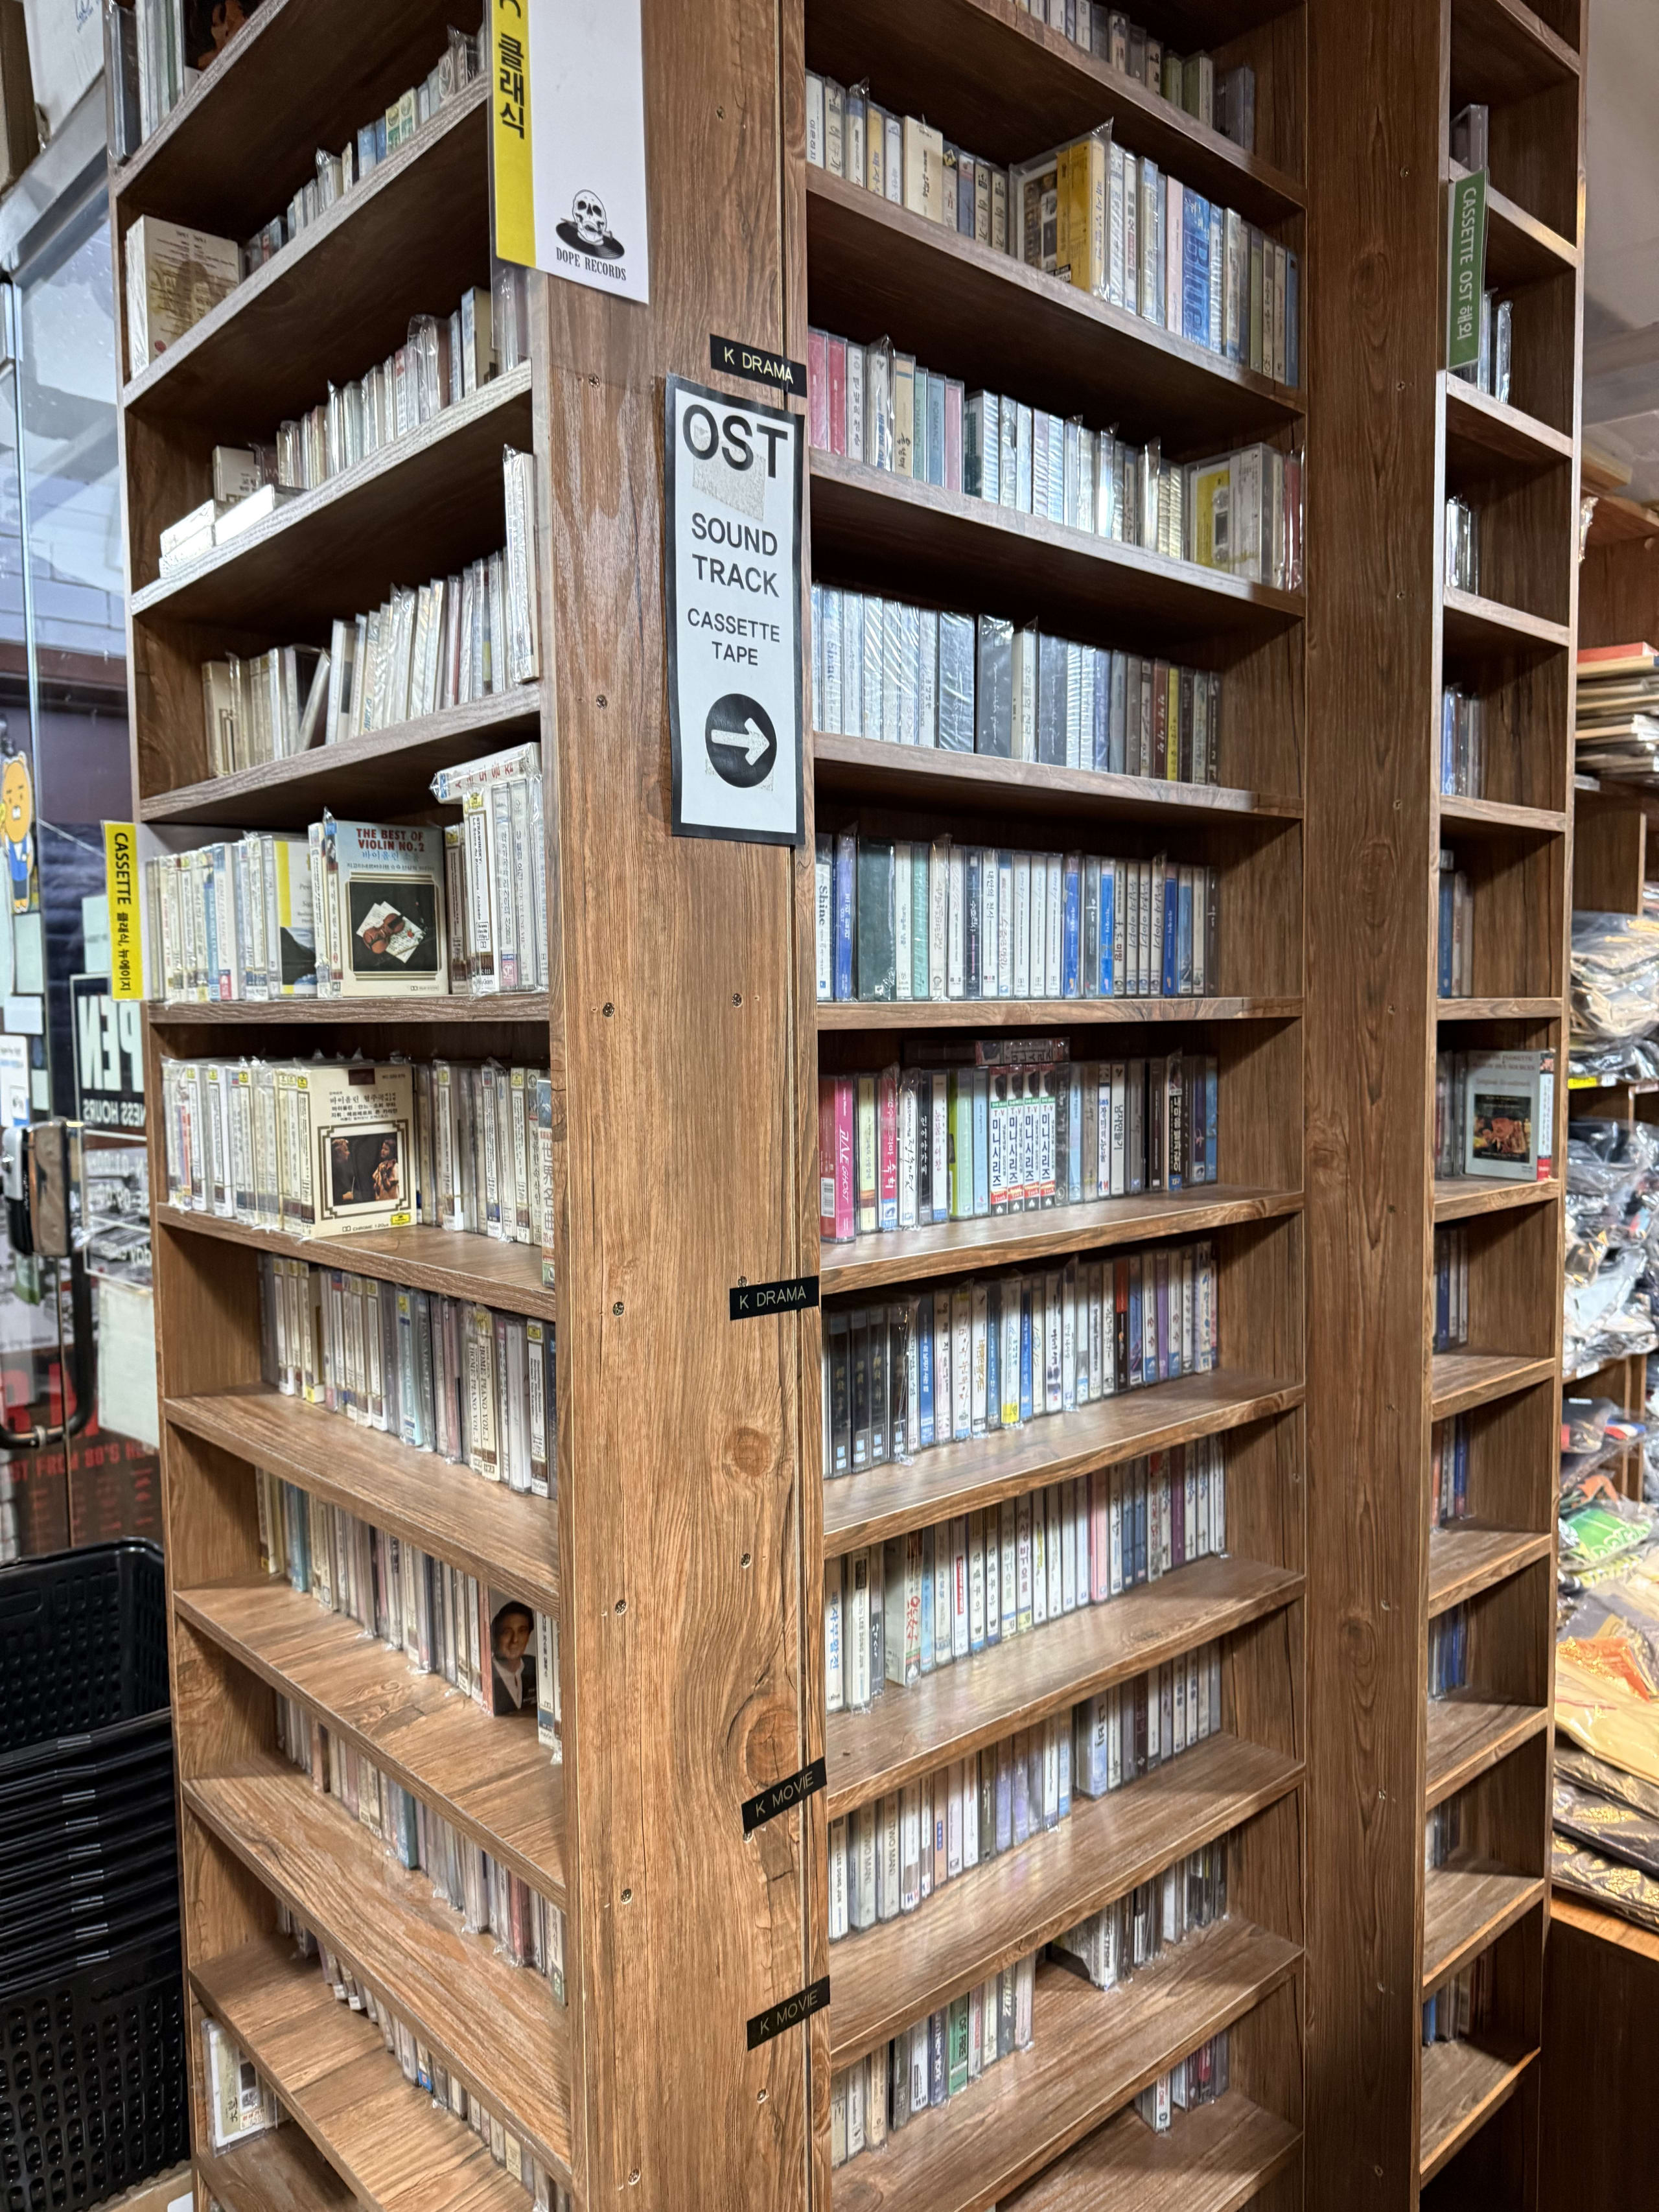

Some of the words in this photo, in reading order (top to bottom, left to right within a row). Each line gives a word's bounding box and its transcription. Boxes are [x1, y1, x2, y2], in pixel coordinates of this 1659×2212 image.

[498, 32, 525, 140] 클래식
[1460, 187, 1477, 266] CASSETTE
[556, 247, 580, 268] DOPE
[585, 256, 627, 281] RECORDS
[1459, 270, 1473, 305] OST
[1457, 306, 1473, 340] 해외
[724, 346, 734, 364] K
[742, 352, 794, 384] DRAMA
[682, 404, 788, 478] OST
[691, 513, 778, 557] SOUND
[692, 554, 780, 598] TRACK
[687, 609, 780, 642] CASSETTE
[712, 641, 759, 666] TAPE
[356, 828, 376, 839] THE
[381, 830, 406, 841] BEST
[411, 831, 424, 841] OF
[358, 839, 395, 850] VIOLIN
[399, 841, 425, 852] NO.2
[114, 832, 132, 905] CASSETTE
[818, 885, 829, 926] Shine
[986, 902, 994, 919] 천사
[117, 913, 131, 946] 클래식,
[118, 949, 132, 992] 뉴에이지
[330, 1095, 359, 1104] 바이올린
[1025, 1114, 1034, 1182] 미니시리즈
[1041, 1113, 1050, 1180] 미니시리즈
[1114, 1104, 1123, 1150] 남자만들기
[992, 1117, 1001, 1187] 미니시리즈
[1009, 1116, 1018, 1183] 미니시리즈
[739, 1294, 749, 1310] K
[756, 1285, 807, 1307] DRAMA
[756, 1800, 765, 1817] K
[772, 1771, 815, 1808] MOVIE
[760, 2017, 770, 2035] K
[777, 1989, 818, 2023] MOVIE
